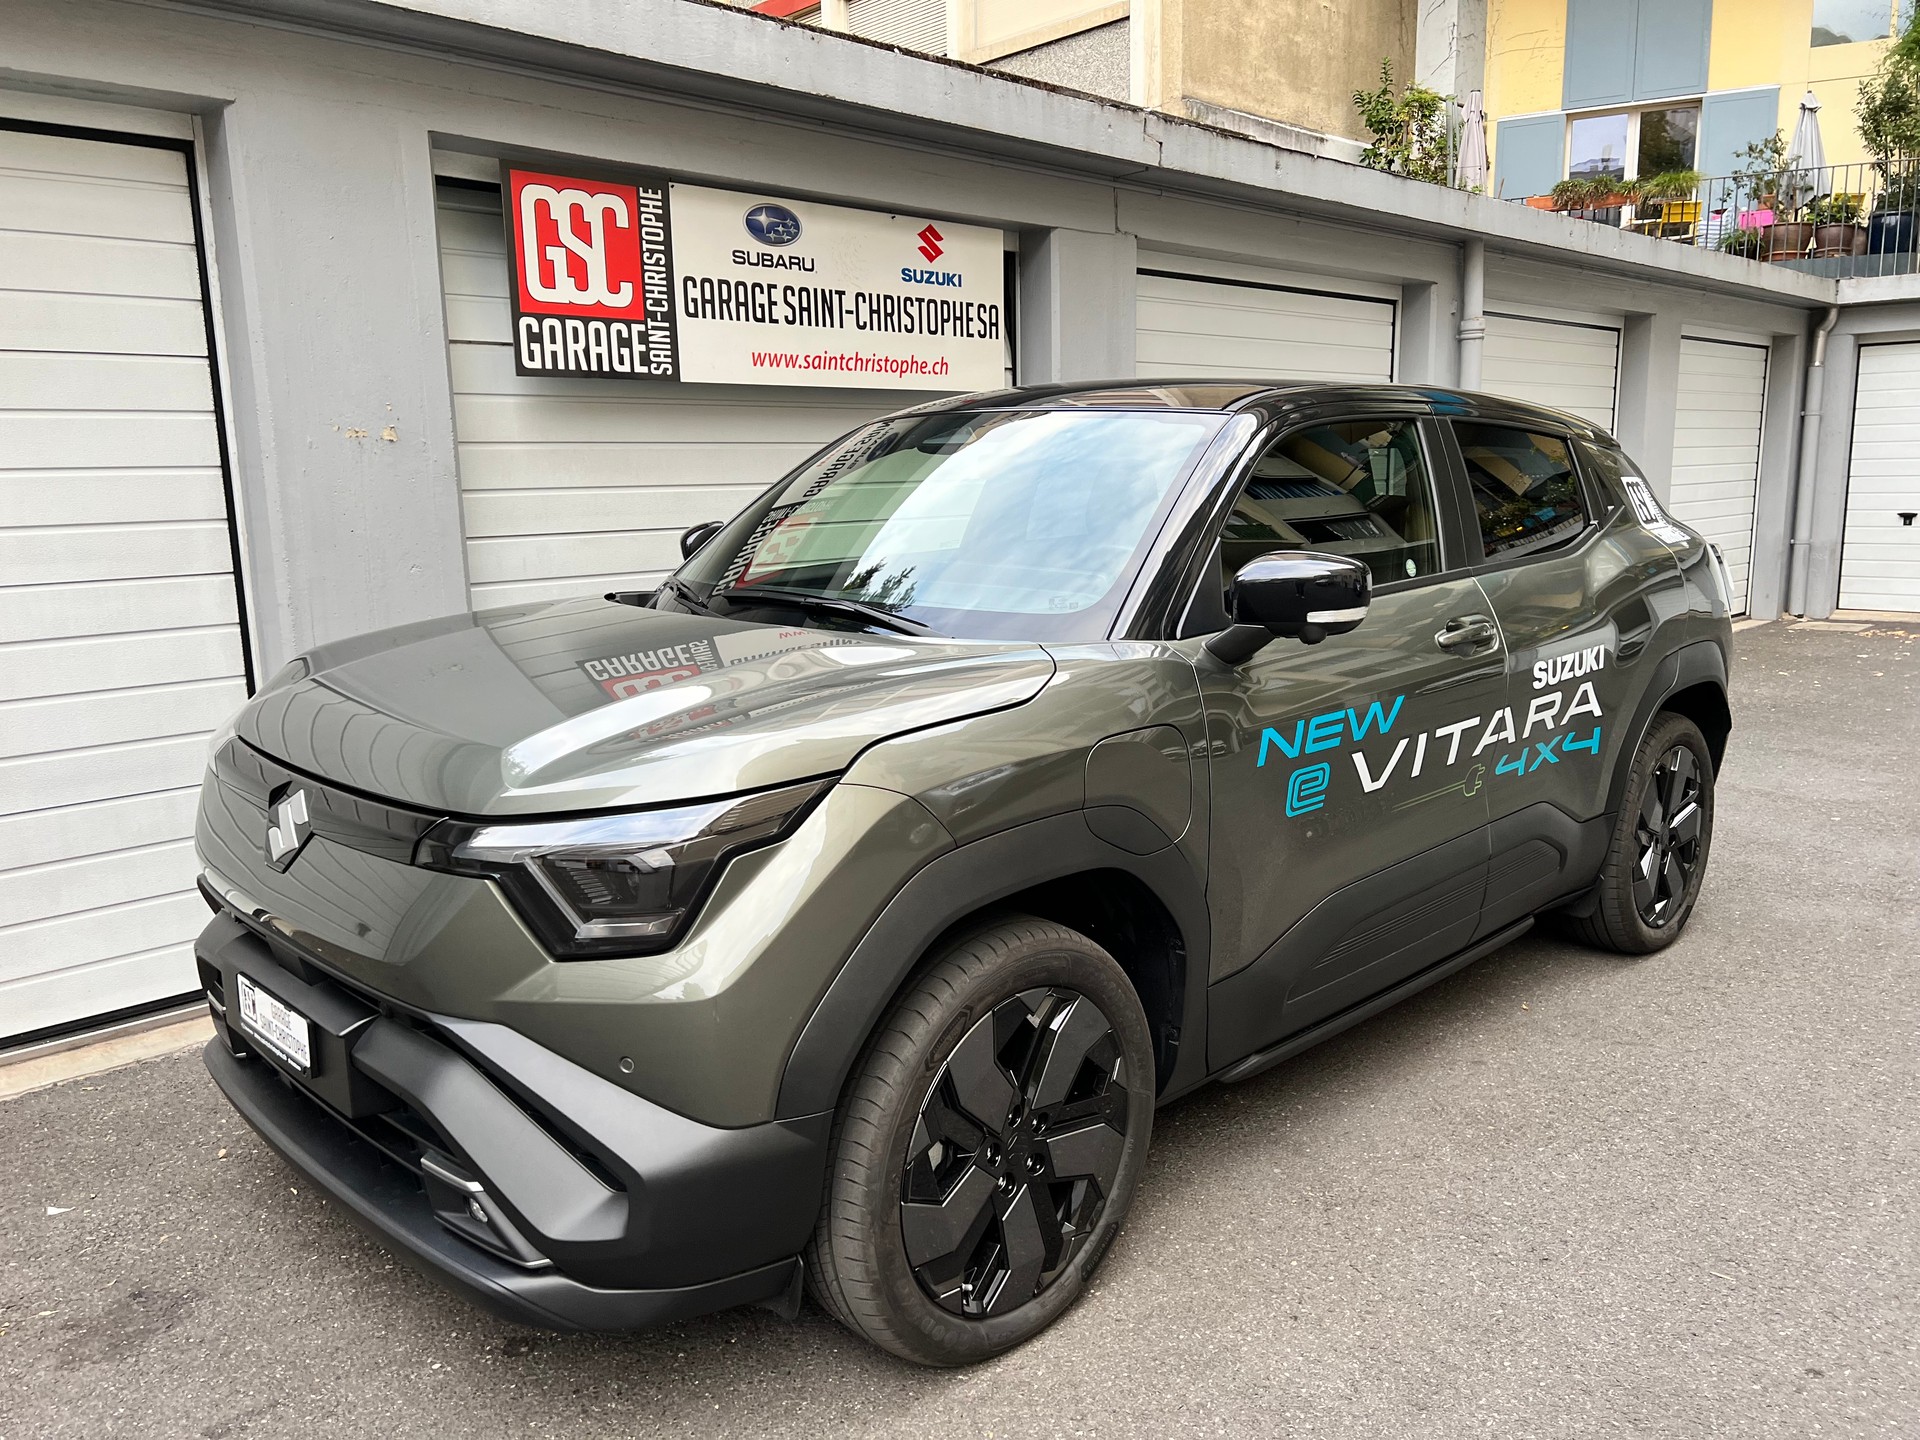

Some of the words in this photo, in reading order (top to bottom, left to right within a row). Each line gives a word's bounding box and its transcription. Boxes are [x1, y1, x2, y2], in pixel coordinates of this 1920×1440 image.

[520, 183, 634, 308] GSC
[732, 249, 815, 273] SUBARU
[639, 187, 673, 376] SAINT-CHRISTOPHE
[682, 275, 780, 325] GARAGE
[782, 284, 975, 339] SAINT-CHRISTOPHE
[976, 302, 1000, 340] SA
[901, 267, 962, 288] SUZUKI
[518, 316, 650, 374] GARAGE
[751, 350, 949, 379] www.saintchristophe.ch
[1532, 644, 1605, 690] SUZUKI
[1256, 695, 1405, 767] NEW
[1351, 681, 1603, 793] VITARA
